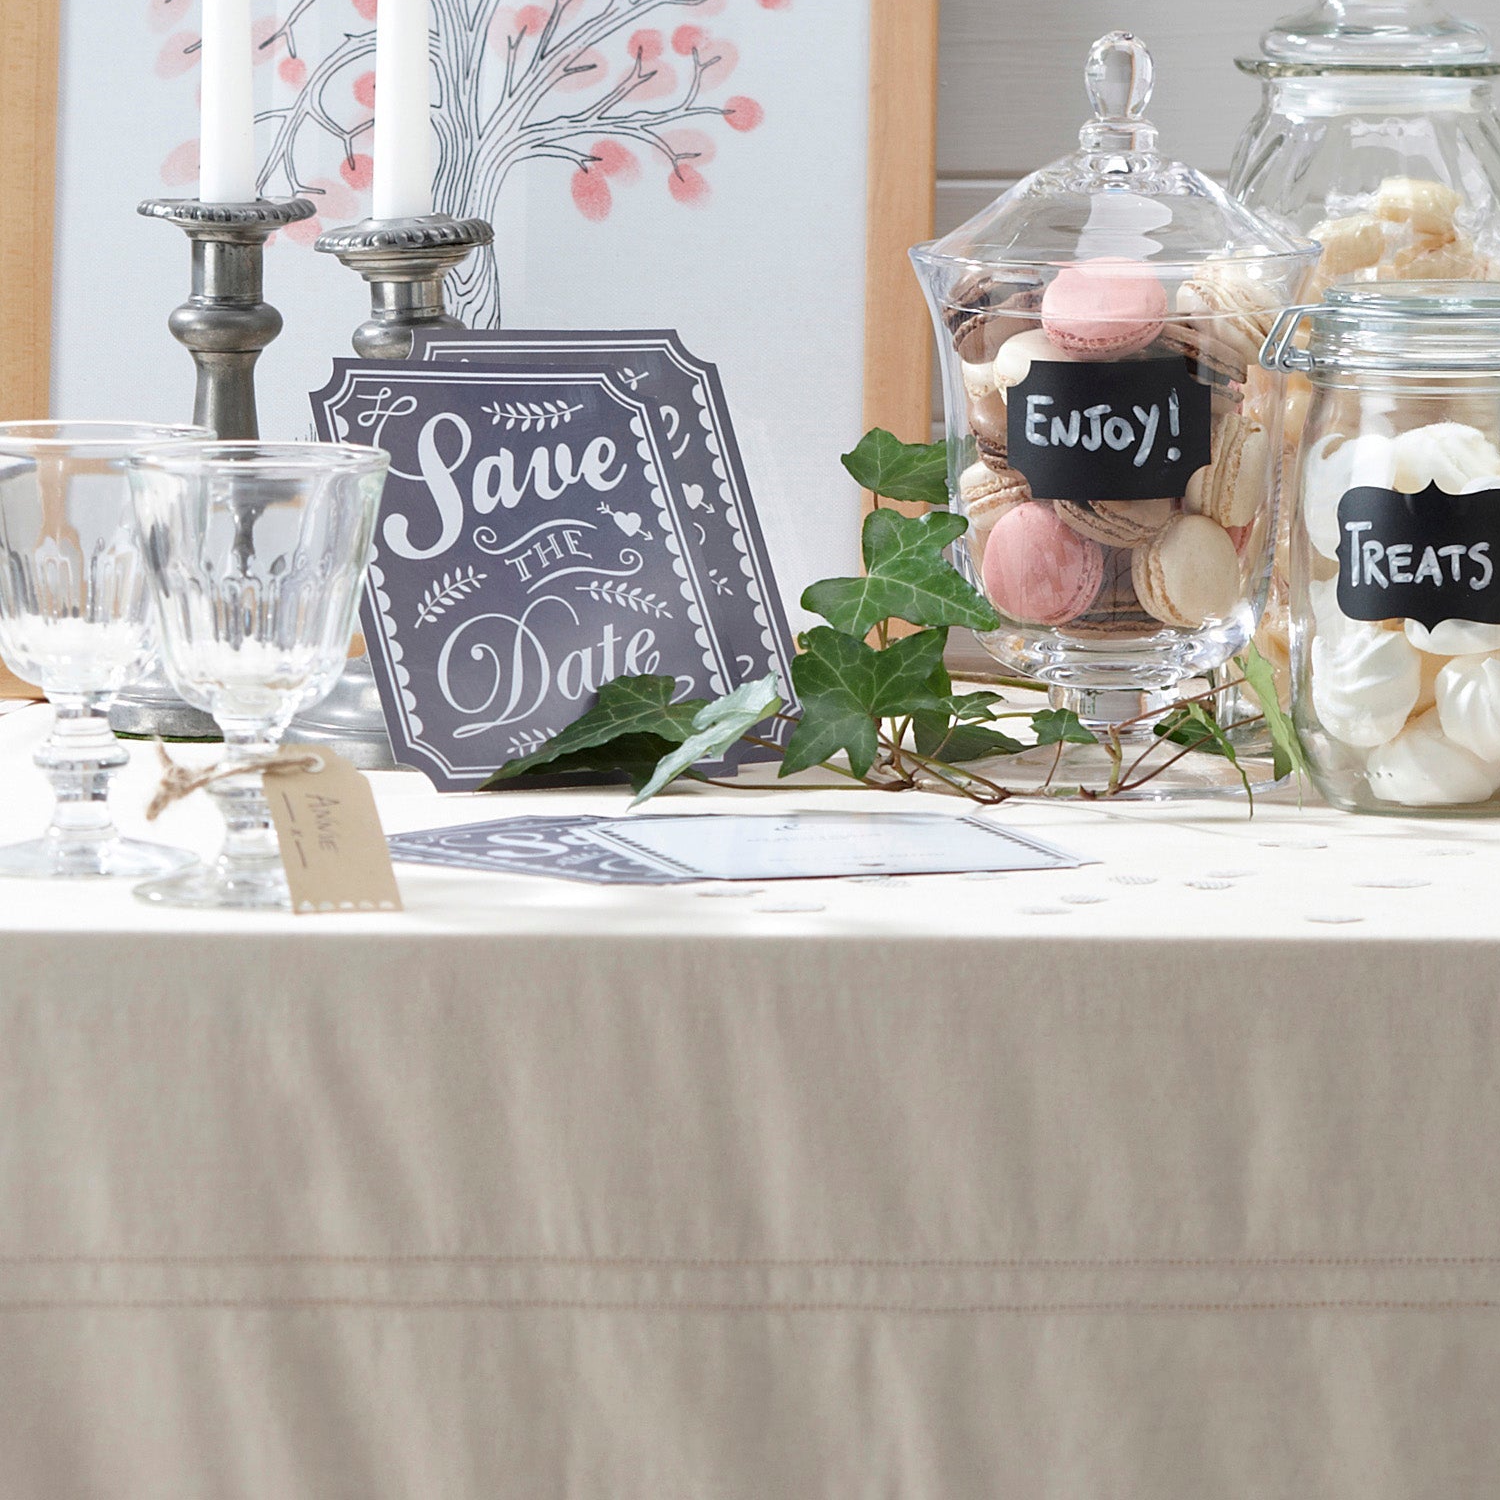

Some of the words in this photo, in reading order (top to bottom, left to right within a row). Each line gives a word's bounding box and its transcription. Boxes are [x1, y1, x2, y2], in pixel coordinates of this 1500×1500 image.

[1025, 387, 1182, 468] ENJOY!
[370, 400, 627, 560] Save
[504, 530, 593, 582] THE
[1344, 520, 1494, 591] TREATS
[437, 595, 662, 739] Date
